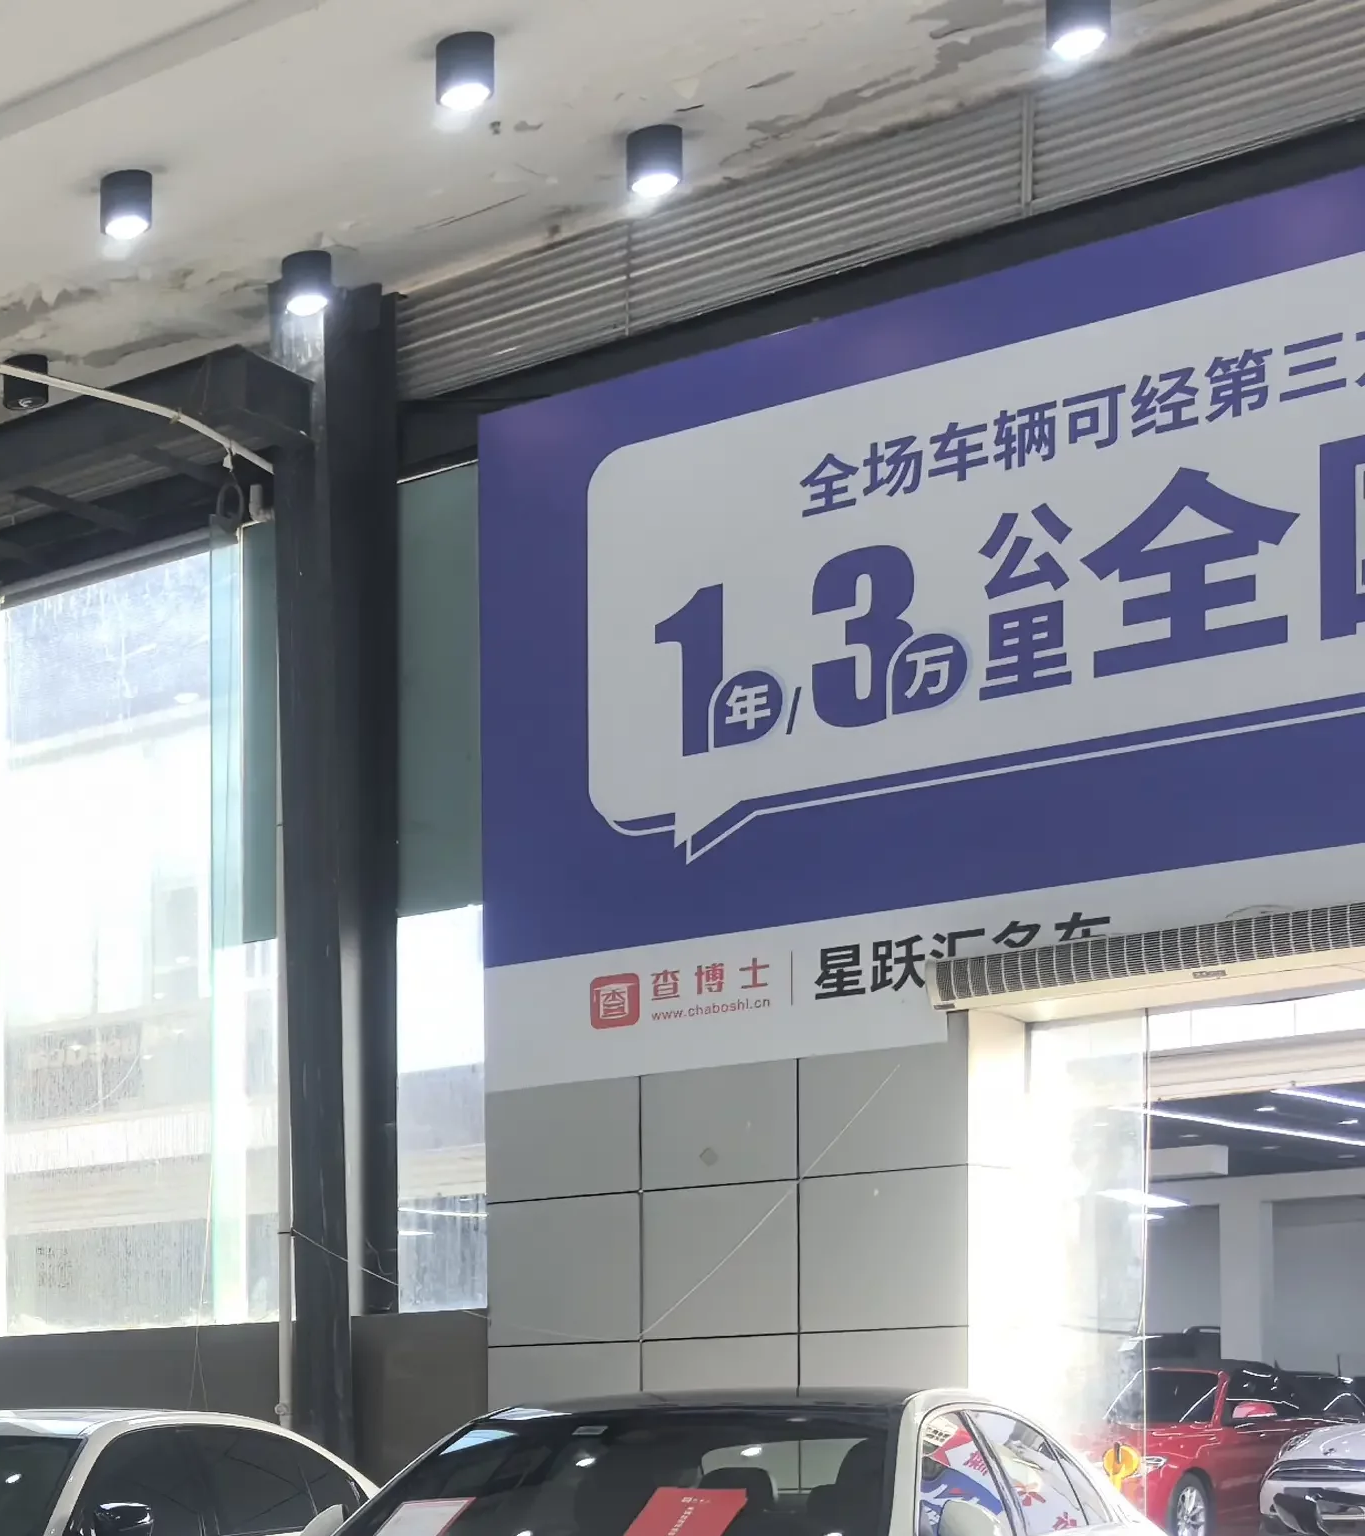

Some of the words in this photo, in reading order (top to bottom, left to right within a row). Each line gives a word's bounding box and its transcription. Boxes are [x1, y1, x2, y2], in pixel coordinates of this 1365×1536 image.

[799, 330, 1365, 518] 全场车辆可经第三
[655, 433, 1365, 757] 1年/3万公里全
[650, 957, 770, 1001] 查博士
[651, 997, 771, 1021] www.chaboshi.cn
